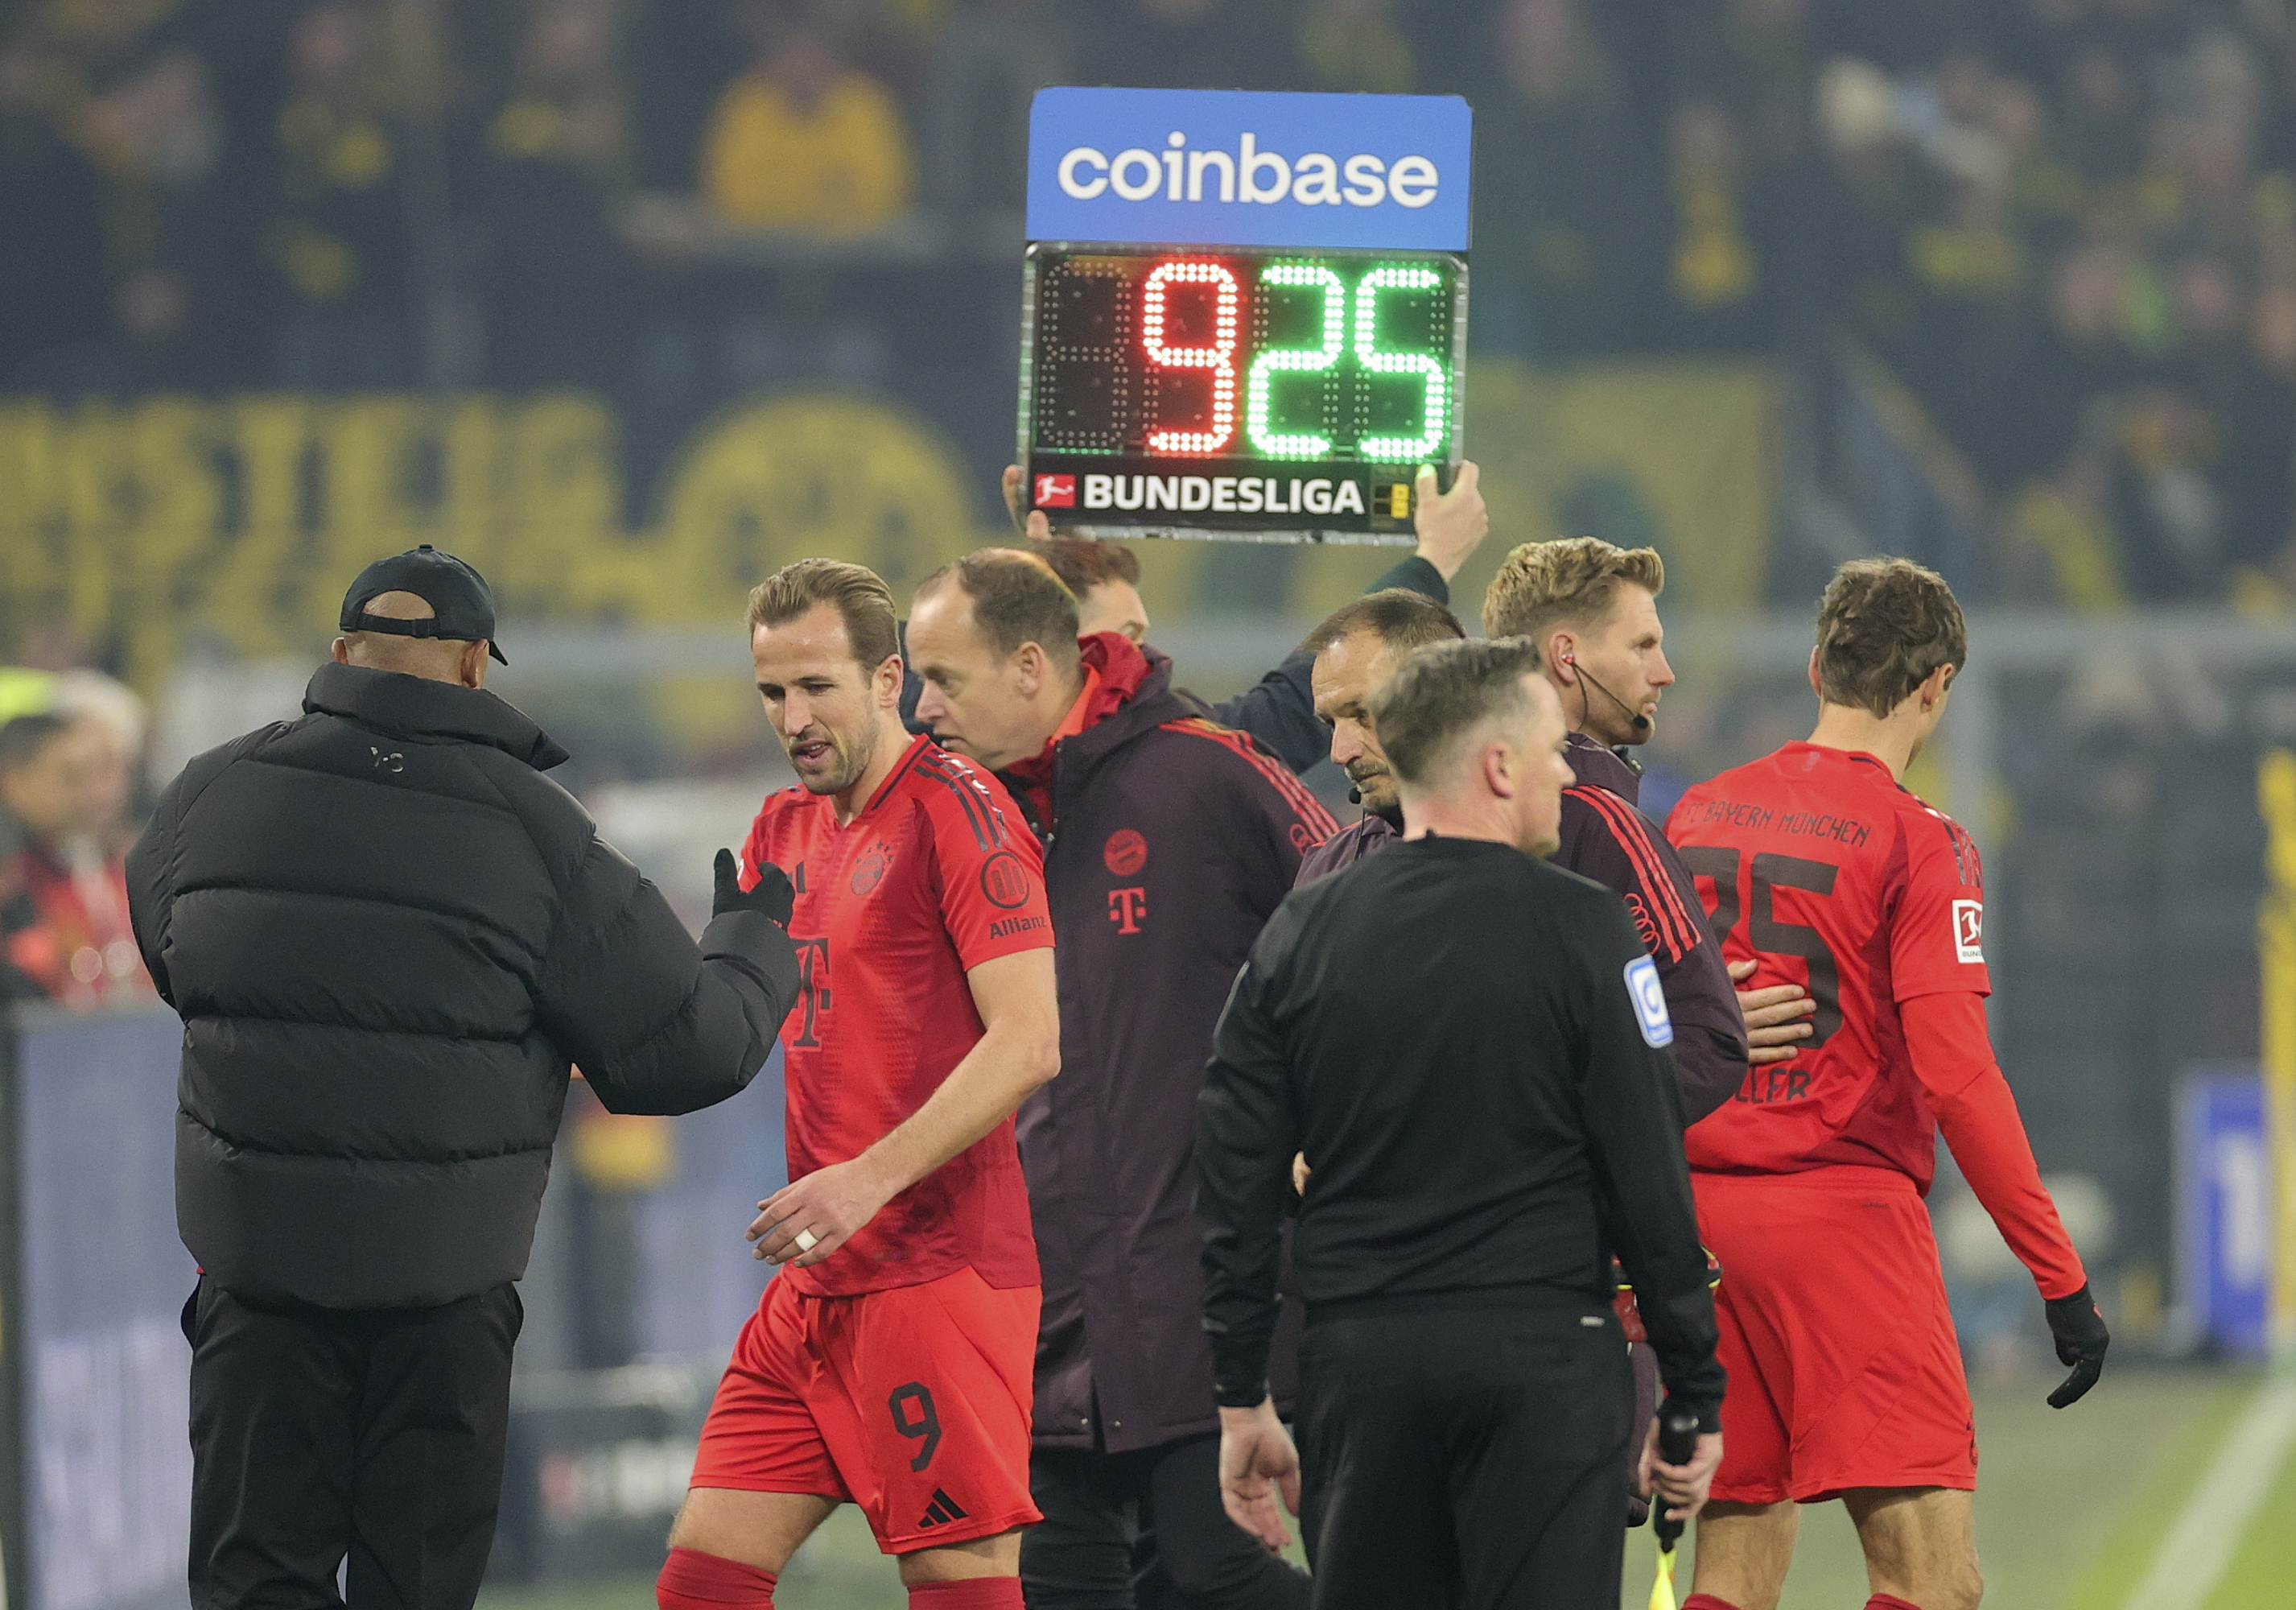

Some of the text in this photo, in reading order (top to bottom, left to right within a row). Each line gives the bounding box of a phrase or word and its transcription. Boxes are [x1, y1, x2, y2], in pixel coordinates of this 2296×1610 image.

[1057, 130, 1439, 208] coinbase
[1143, 262, 1445, 459] 9 25
[1083, 474, 1365, 515] BUNDESLIGA
[1703, 800, 1775, 829] BAYERN
[888, 1381, 942, 1473] 9
